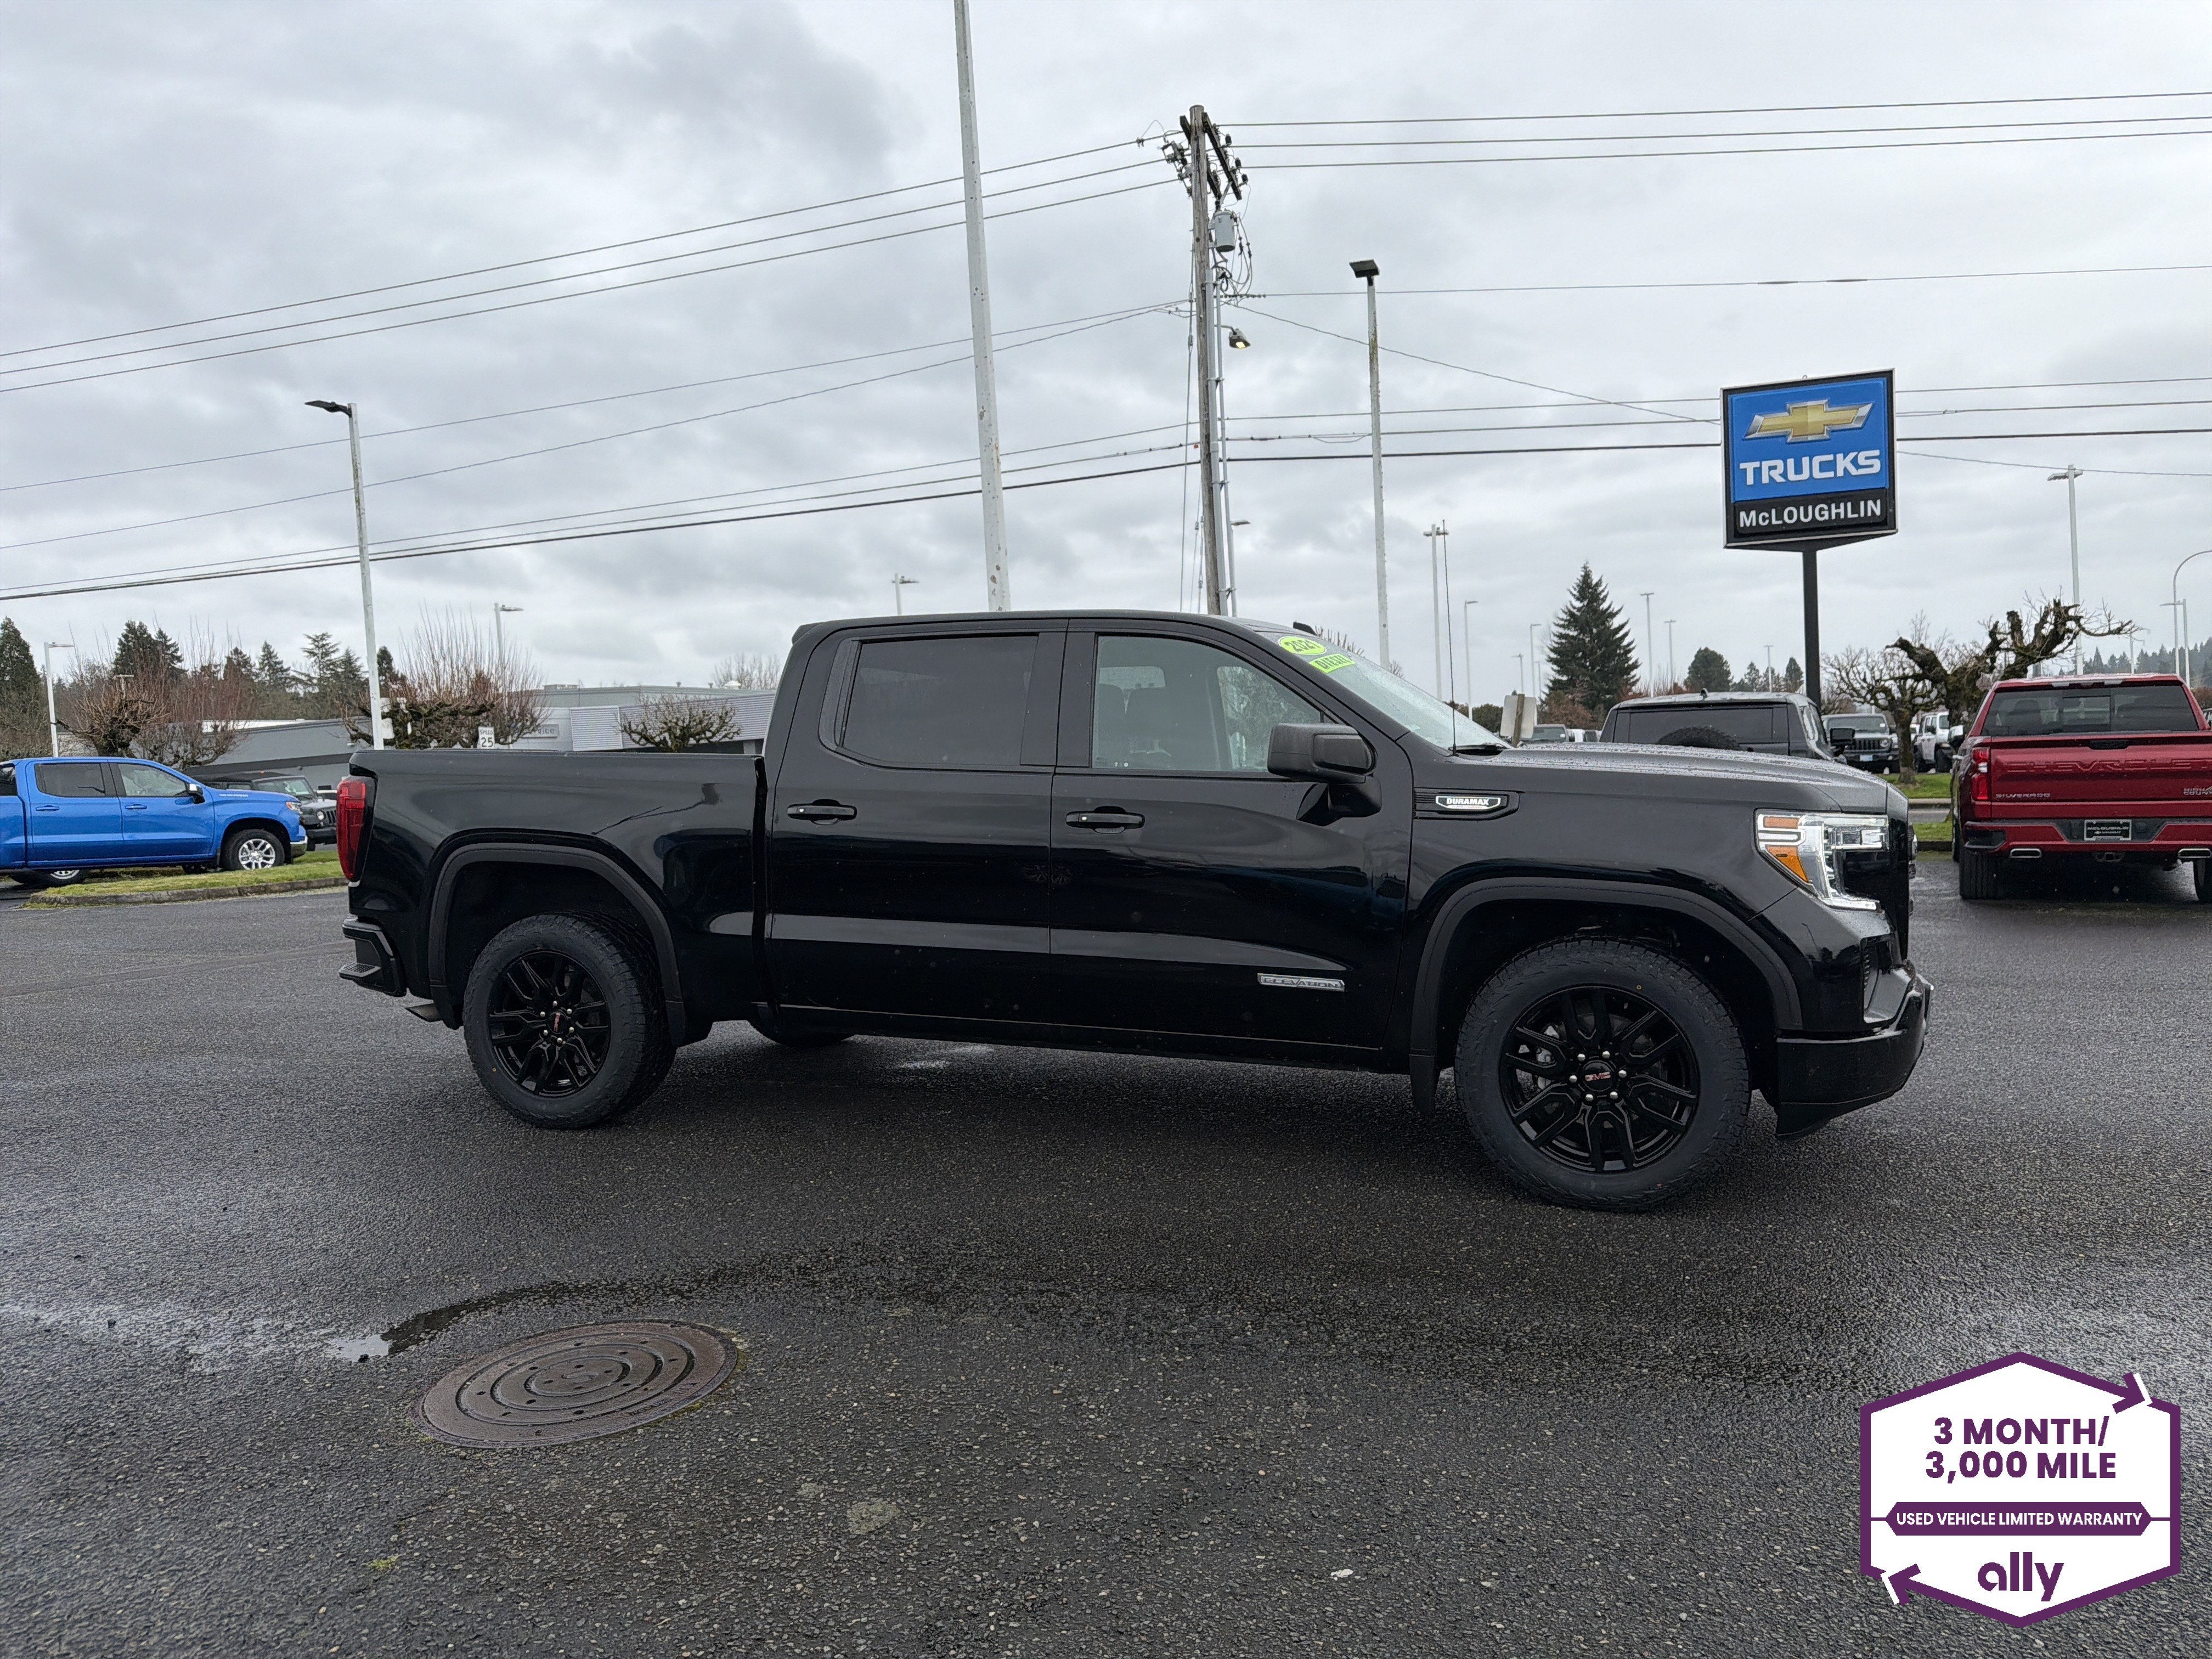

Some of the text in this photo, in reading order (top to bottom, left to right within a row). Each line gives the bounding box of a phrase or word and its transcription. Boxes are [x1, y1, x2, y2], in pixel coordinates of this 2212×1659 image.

[1739, 449, 1881, 486] TRUCKS
[1740, 499, 1882, 528] McLOUGHLIN
[1284, 639, 1322, 652] 2021
[1314, 655, 1352, 669] DIESEL
[481, 737, 494, 748] 25
[1263, 978, 1338, 988] ELEVATION
[1584, 1071, 1611, 1082] GMC
